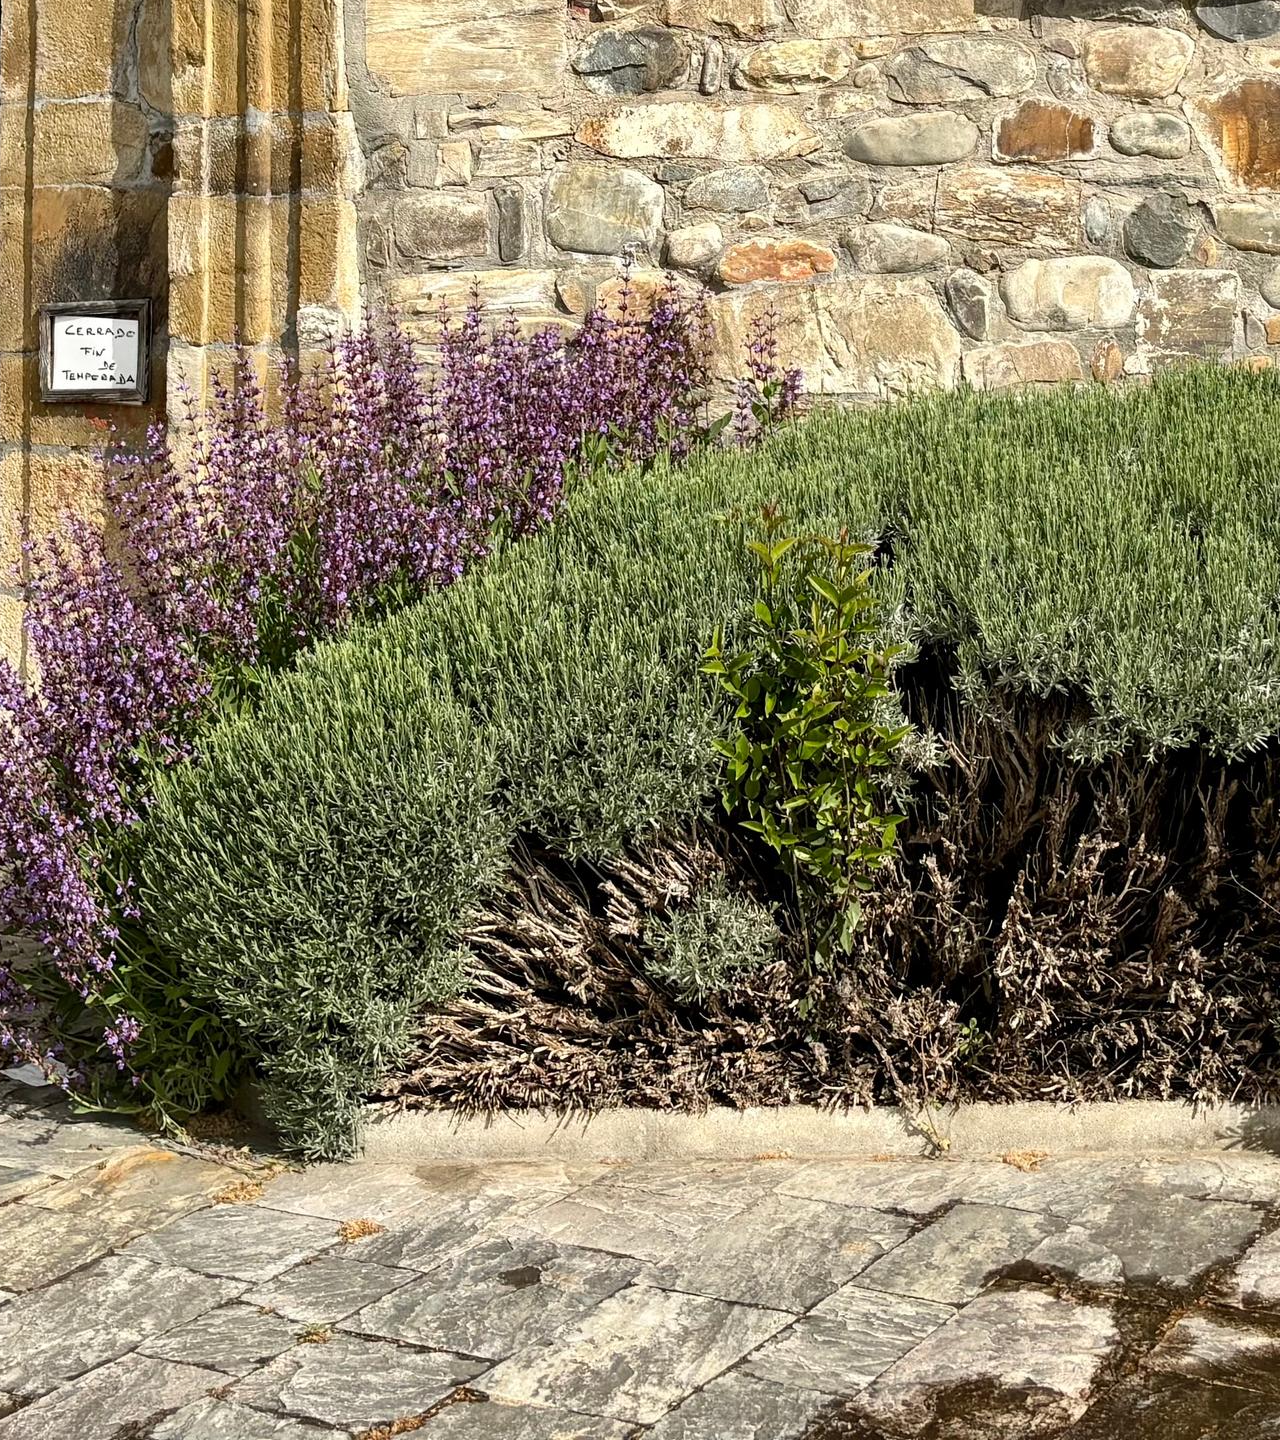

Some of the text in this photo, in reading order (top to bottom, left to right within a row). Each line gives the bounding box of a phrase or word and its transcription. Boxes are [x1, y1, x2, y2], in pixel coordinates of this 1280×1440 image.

[64, 324, 136, 339] CERRADO
[98, 360, 116, 370] DE
[61, 369, 135, 385] TEMPORADA
